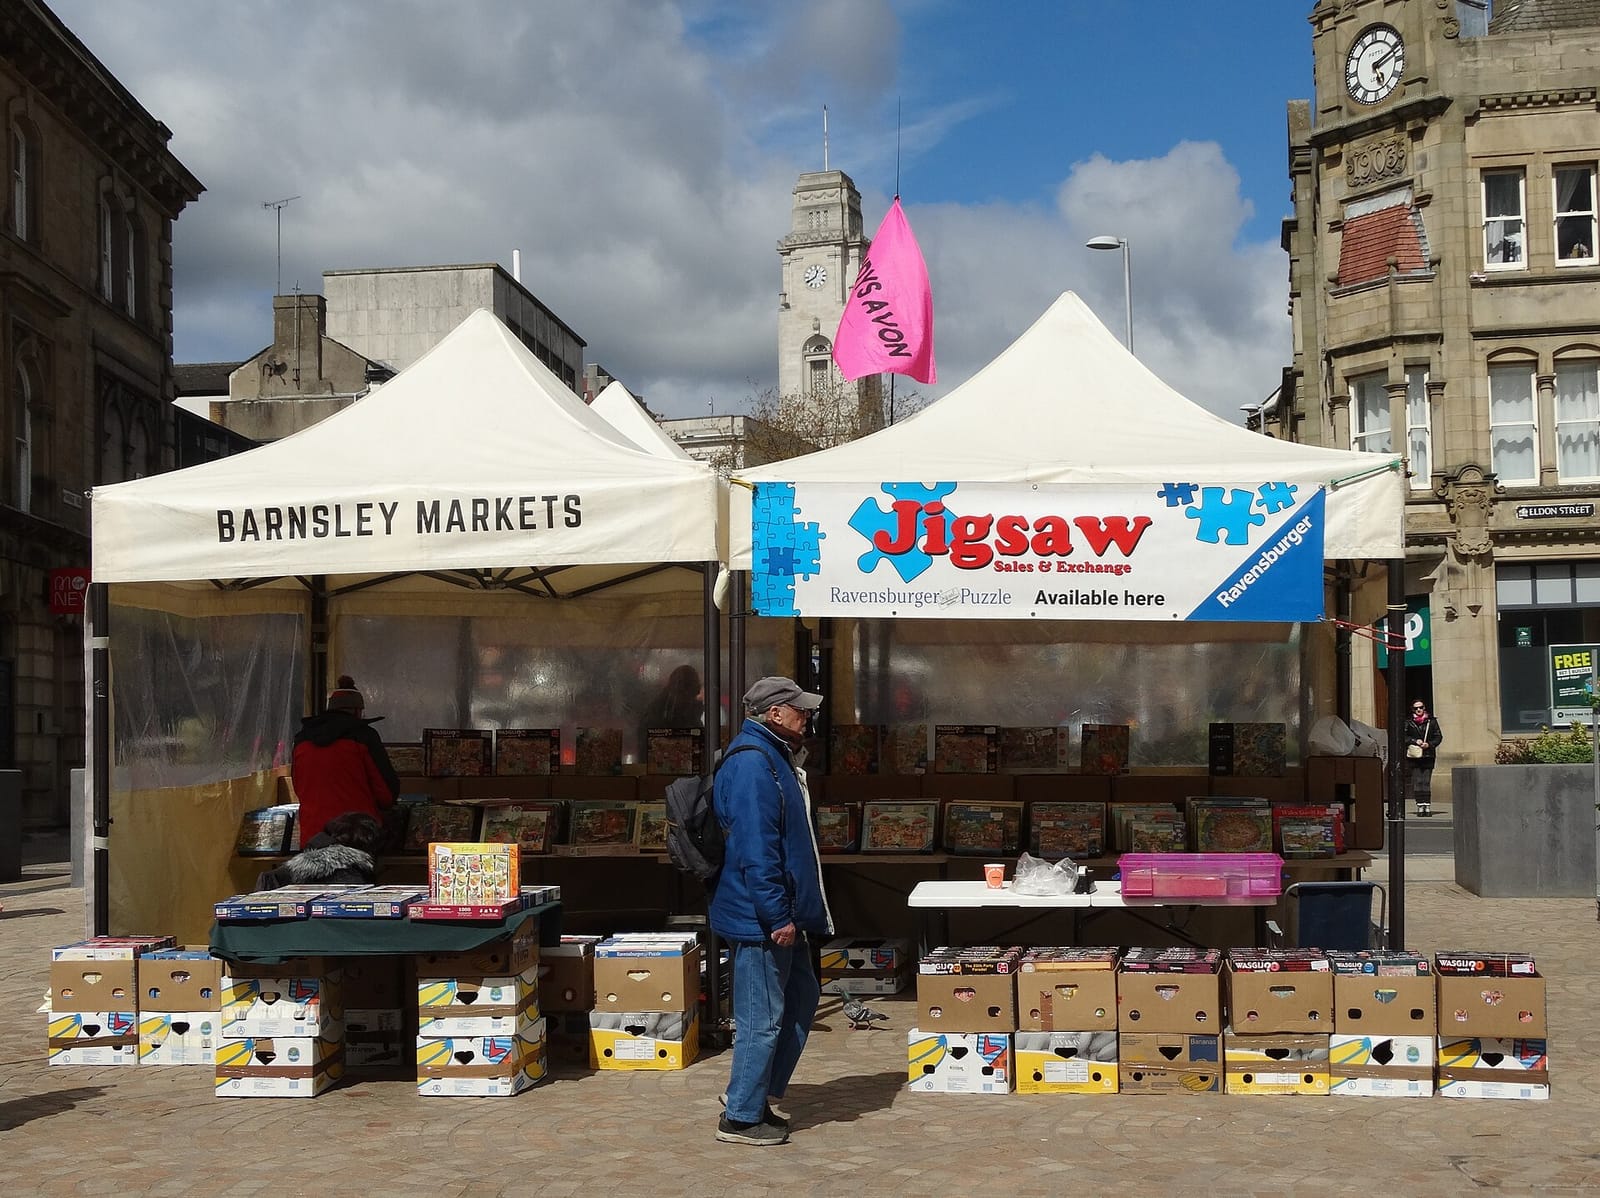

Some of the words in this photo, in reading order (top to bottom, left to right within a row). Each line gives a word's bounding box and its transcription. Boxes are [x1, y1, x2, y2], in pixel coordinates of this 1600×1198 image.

[861, 300, 912, 357] AVON
[217, 501, 399, 543] BARNSLEY
[416, 494, 583, 535] MARKETS
[1529, 507, 1558, 516] ELDON
[1558, 505, 1591, 515] STREET
[873, 498, 1153, 570] Jigsaw
[993, 560, 1034, 573] Sales
[1038, 561, 1052, 573] &
[1056, 561, 1132, 576] Exchange
[1215, 514, 1314, 609] Ravensburger
[830, 586, 941, 607] Ravensburger
[961, 588, 1012, 605] Puzzle
[1034, 589, 1119, 606] Available
[1123, 589, 1165, 606] here
[1554, 652, 1591, 669] FREE
